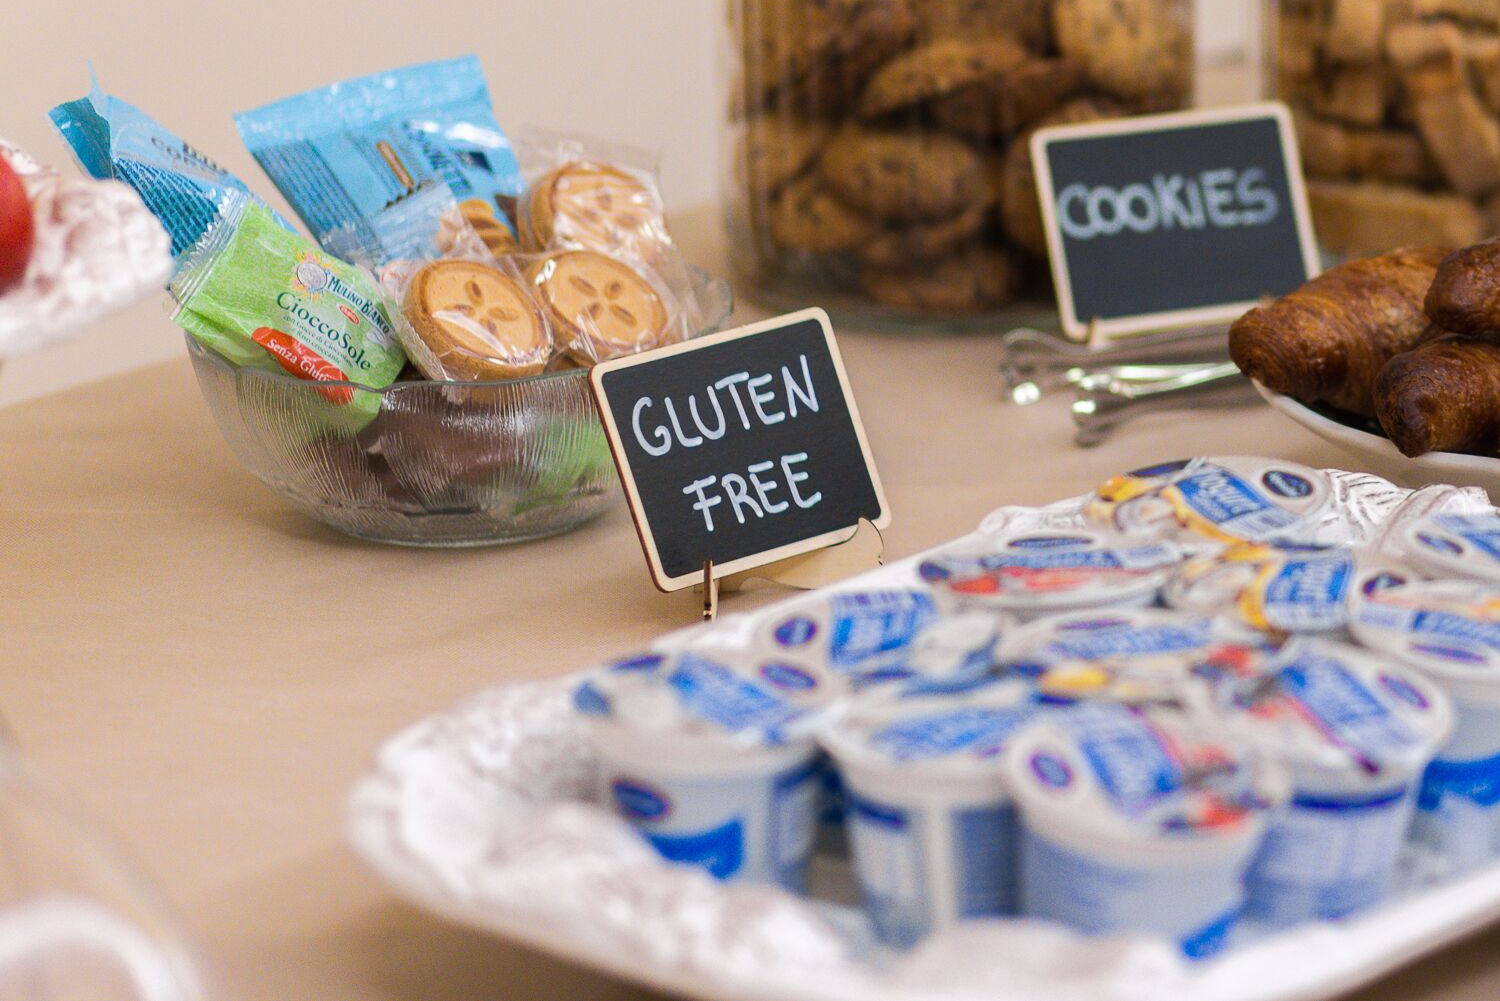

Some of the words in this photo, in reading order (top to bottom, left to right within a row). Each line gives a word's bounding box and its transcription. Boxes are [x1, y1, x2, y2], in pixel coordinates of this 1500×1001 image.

[1057, 167, 1280, 240] COOKIES
[266, 338, 298, 365] Senza
[277, 291, 372, 371] CioccoSole
[632, 354, 819, 456] GLUTEN
[683, 452, 822, 532] FREE
